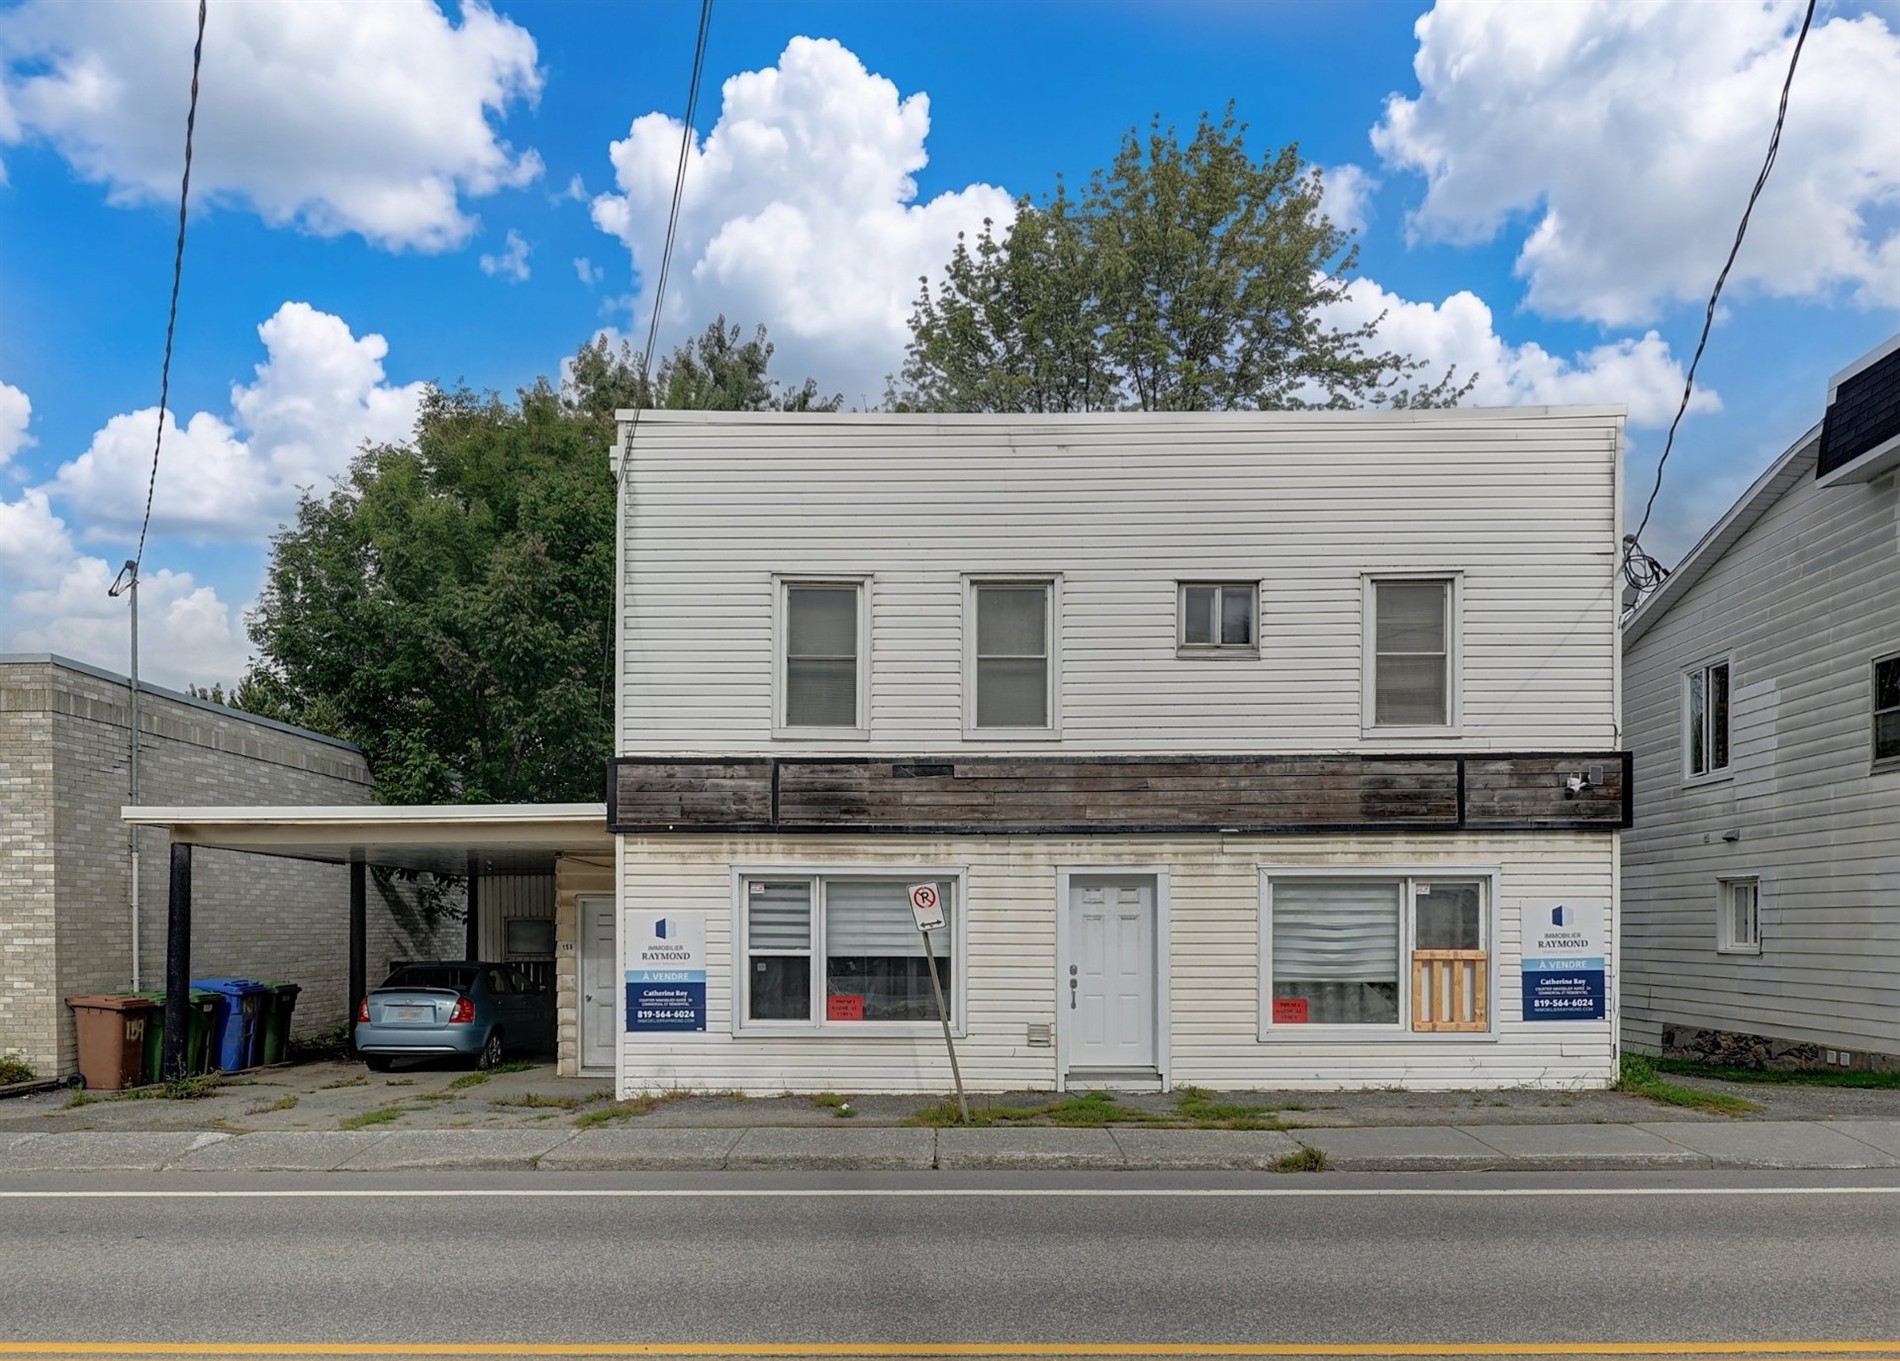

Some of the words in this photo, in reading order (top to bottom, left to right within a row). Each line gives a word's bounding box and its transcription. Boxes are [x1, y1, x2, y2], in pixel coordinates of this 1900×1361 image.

[1538, 940, 1588, 948] RAYMOND
[641, 952, 691, 960] RAYMOND
[1549, 960, 1588, 969] VENDRE
[652, 972, 689, 981] VENDRE
[1573, 978, 1586, 986] Roy
[675, 990, 688, 998] Roy
[1534, 999, 1594, 1007] 819-564-6024
[637, 1010, 695, 1018] 819-564-6024
[126, 1018, 144, 1041] 159
